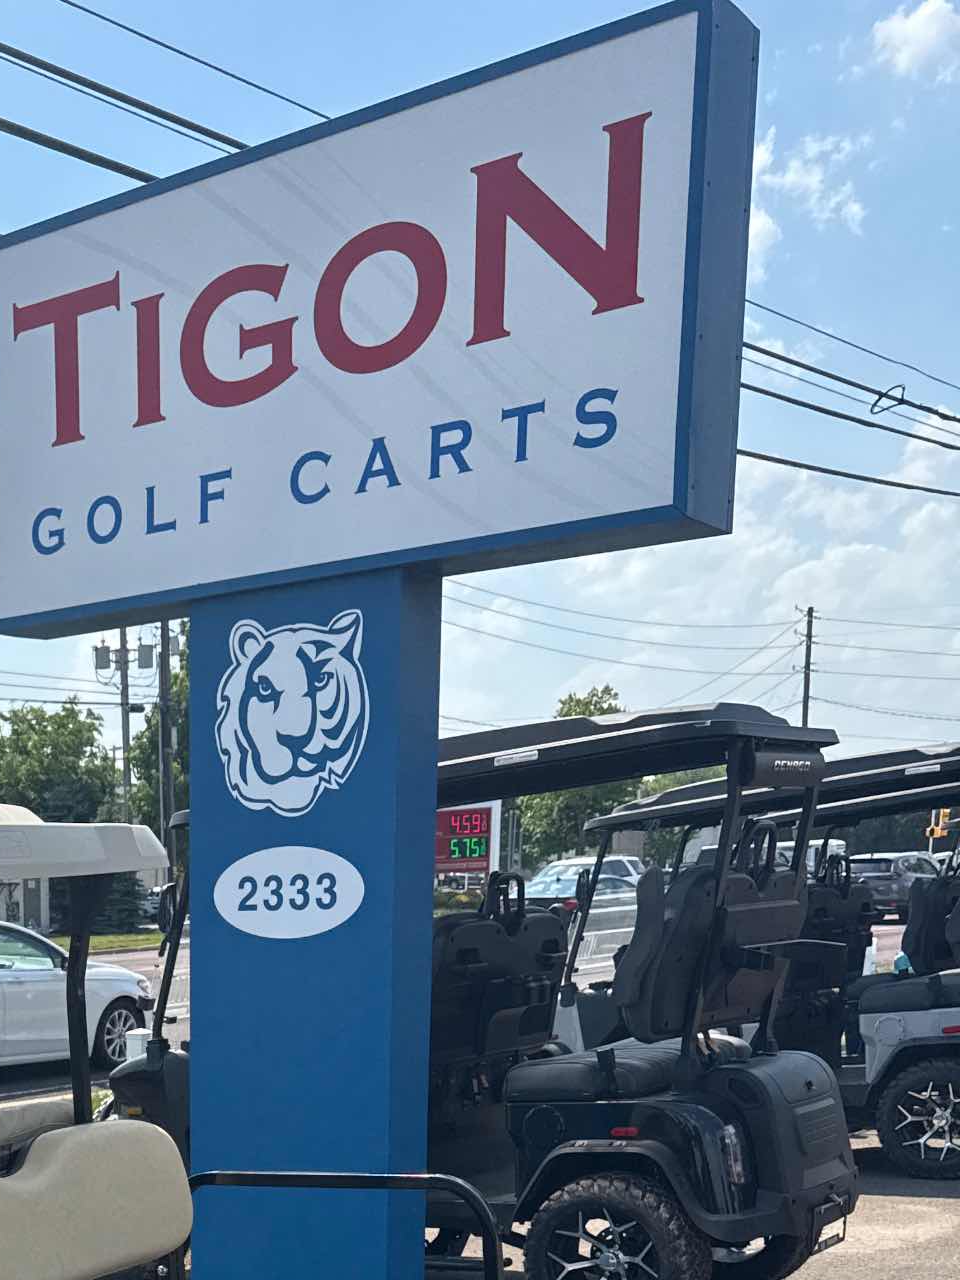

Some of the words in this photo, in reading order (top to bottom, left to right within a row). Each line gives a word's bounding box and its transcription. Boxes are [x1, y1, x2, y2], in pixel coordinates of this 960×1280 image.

[12, 111, 653, 447] TIGON
[32, 469, 232, 555] GOLF
[290, 388, 619, 504] CARTS
[238, 872, 337, 911] 2333
